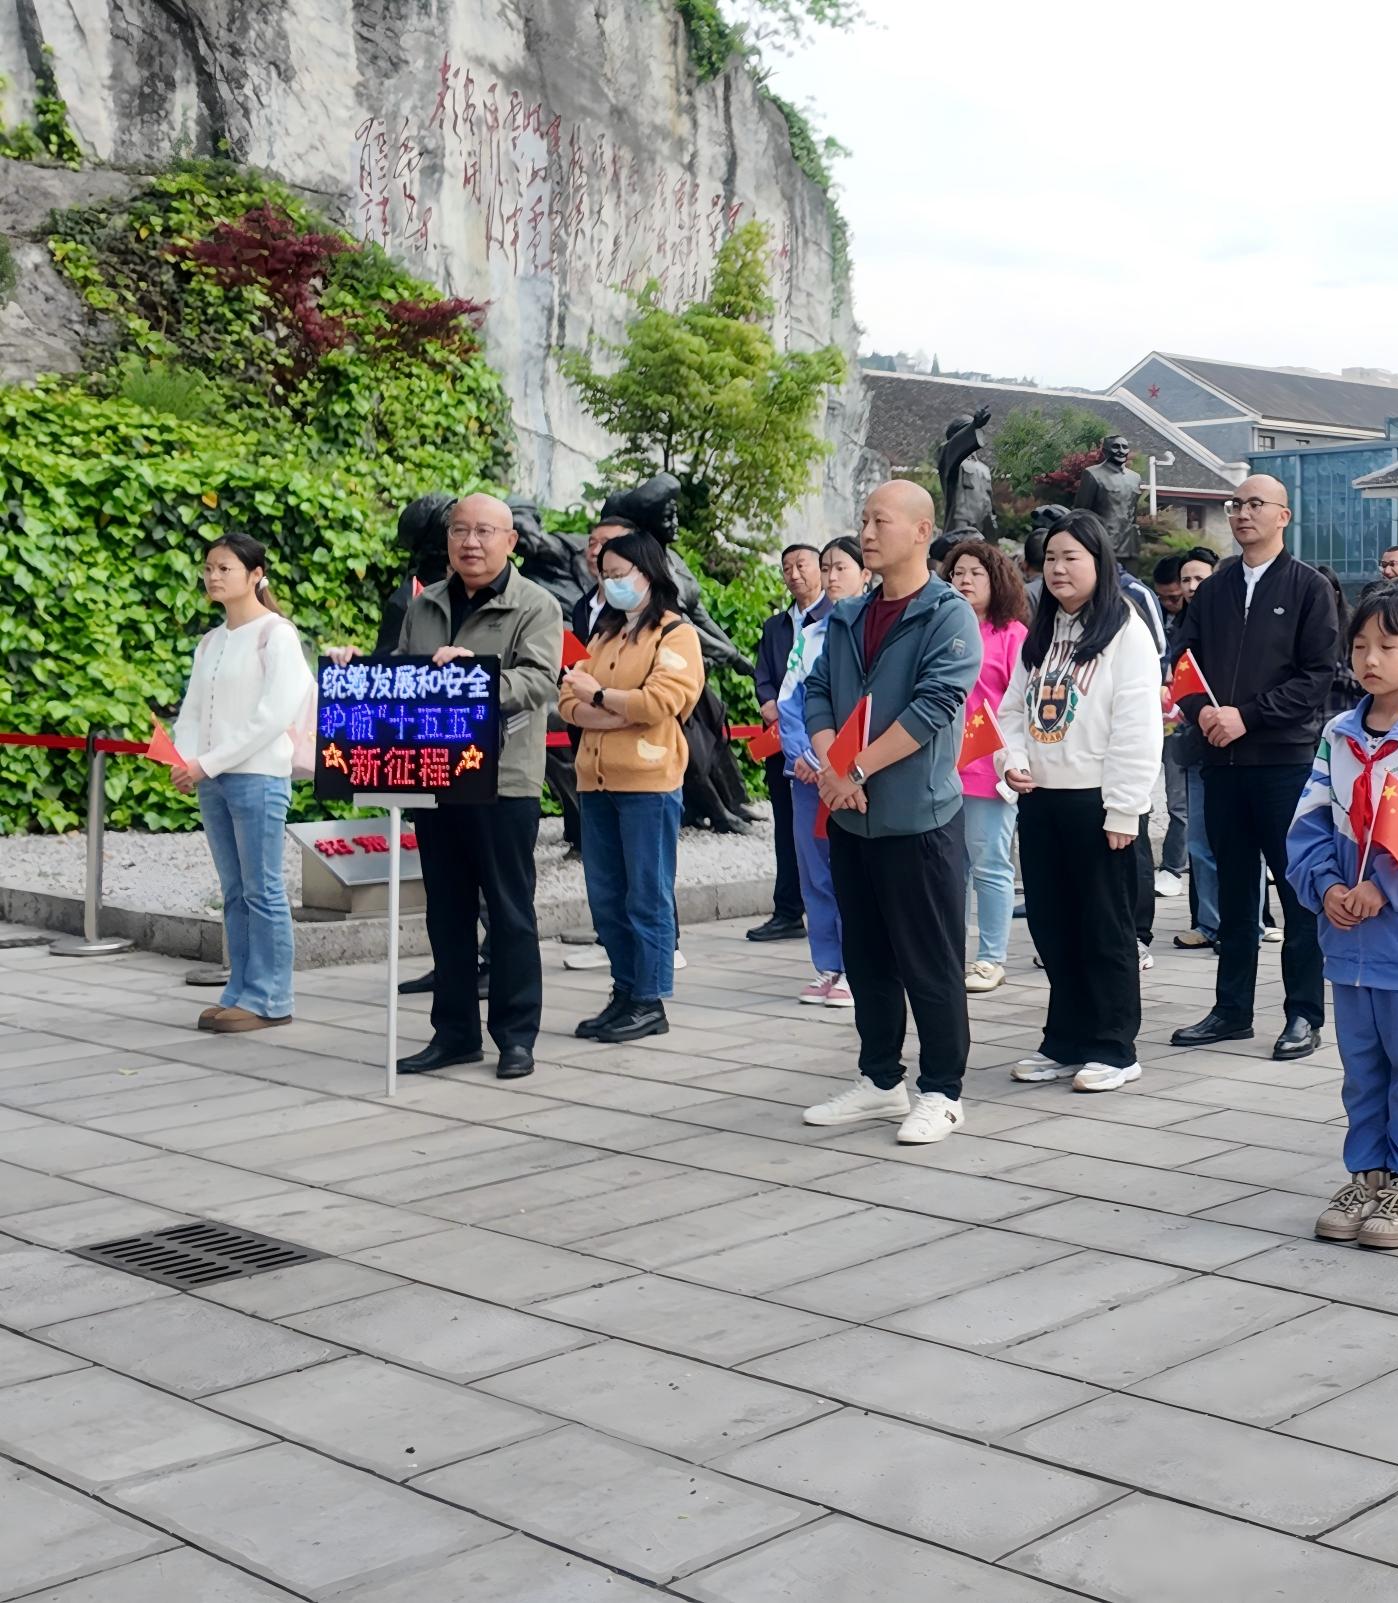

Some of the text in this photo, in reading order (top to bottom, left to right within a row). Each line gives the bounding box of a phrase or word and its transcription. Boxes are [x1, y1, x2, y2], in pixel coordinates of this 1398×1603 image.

[322, 662, 491, 700] 统筹发展和安全
[350, 745, 450, 787] 新征程
